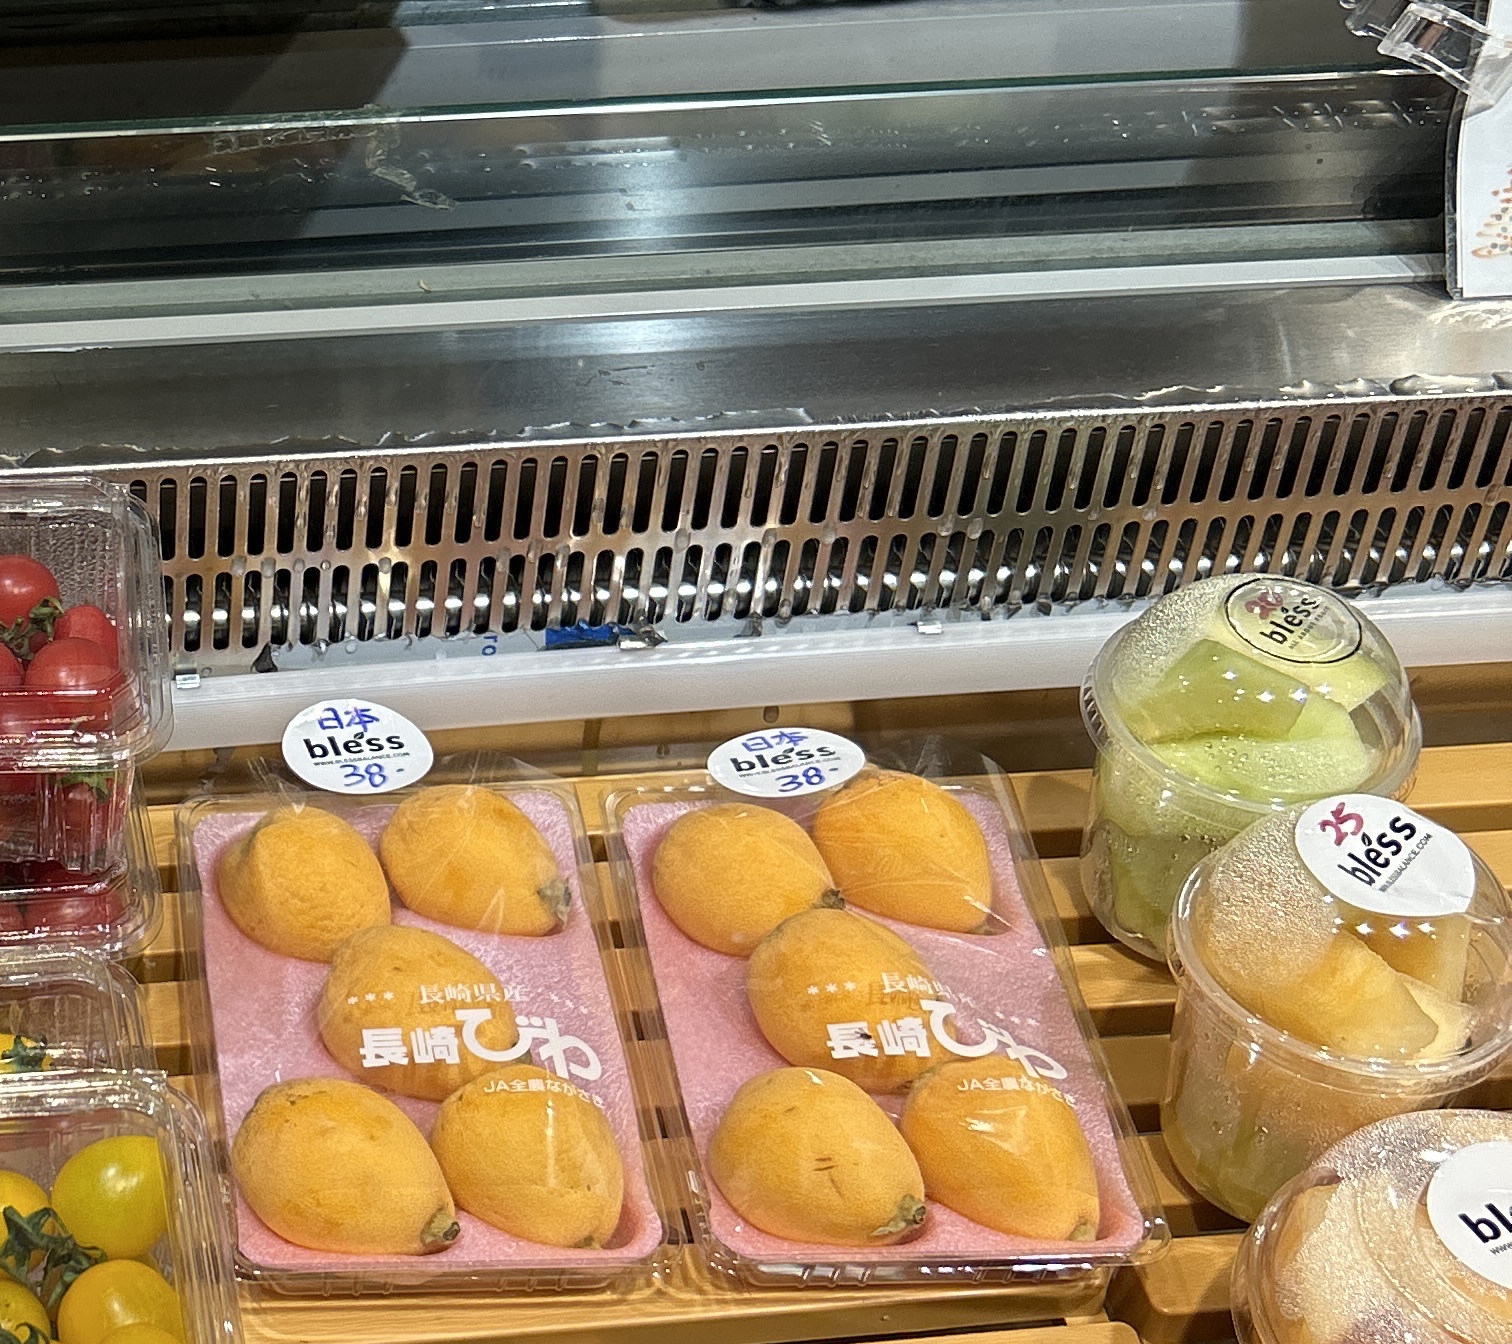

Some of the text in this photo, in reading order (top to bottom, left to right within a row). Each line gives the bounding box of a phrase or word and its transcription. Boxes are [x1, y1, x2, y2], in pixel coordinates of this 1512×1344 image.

[1259, 594, 1323, 645] bless
[317, 706, 380, 733] 日本
[302, 732, 405, 759] bless
[729, 746, 837, 773] bless
[741, 731, 809, 752] 日本
[1319, 802, 1364, 846] 25
[1338, 816, 1417, 886] bless
[359, 1009, 602, 1081] 長崎びわ
[1457, 1203, 1512, 1244] bl
